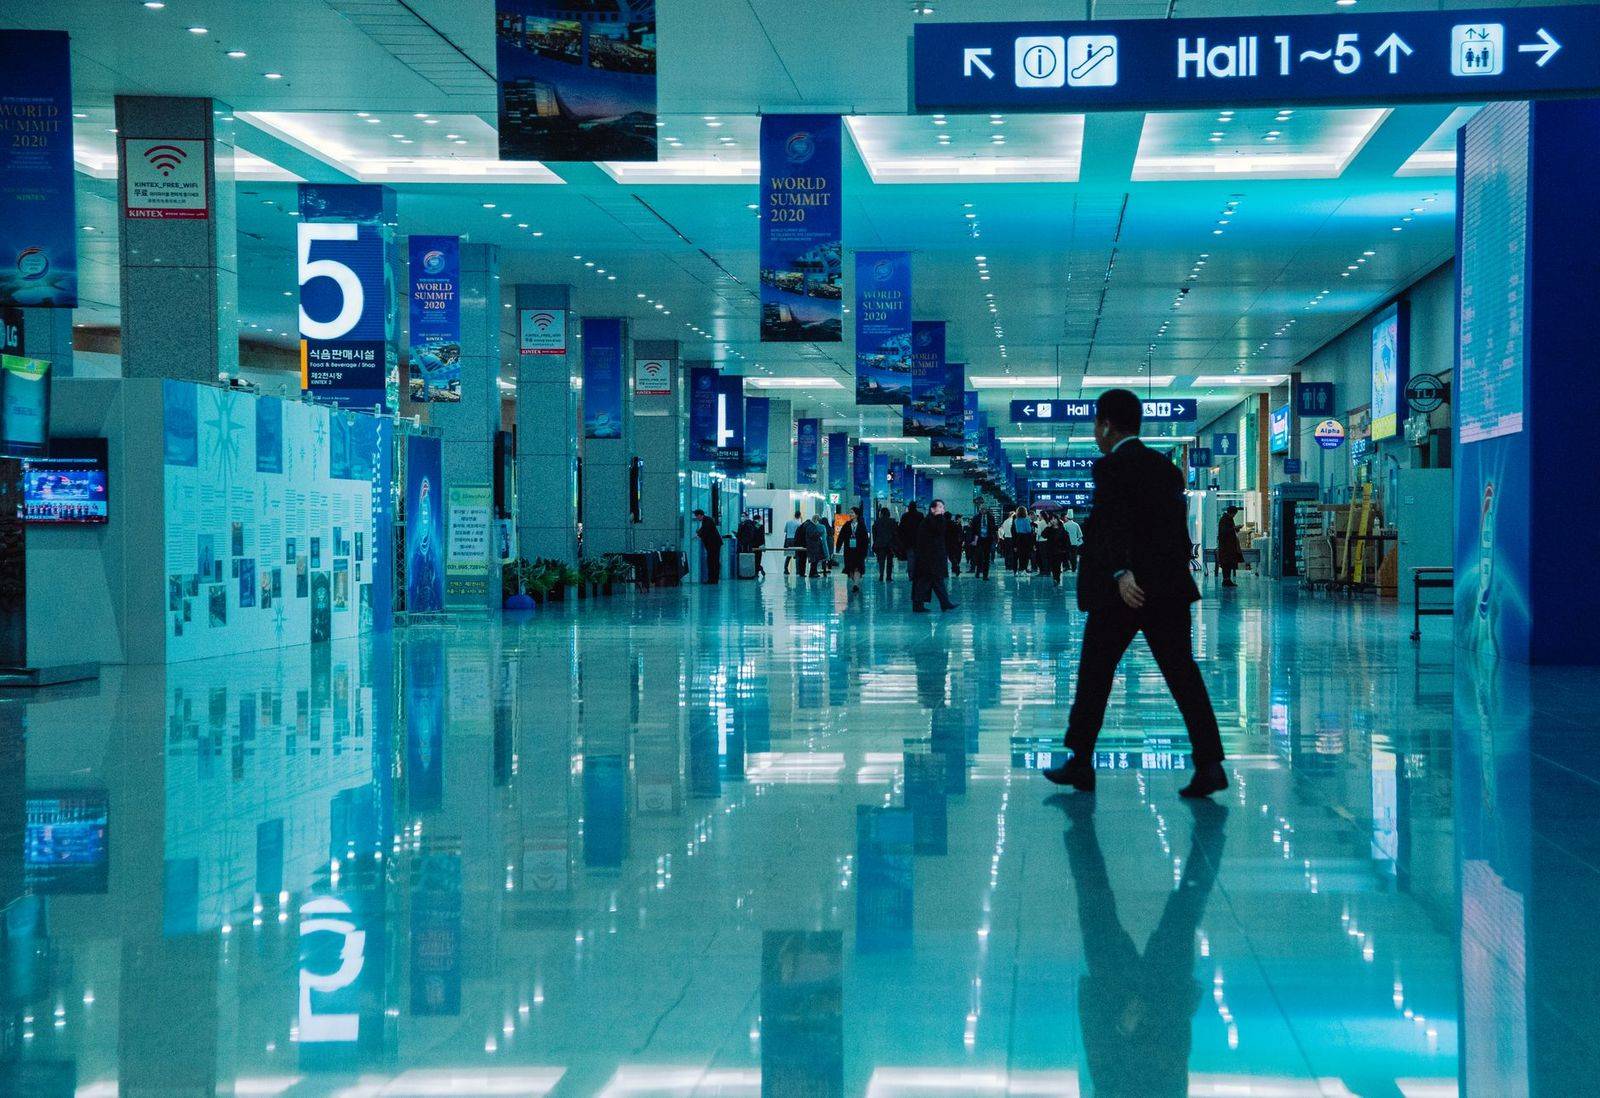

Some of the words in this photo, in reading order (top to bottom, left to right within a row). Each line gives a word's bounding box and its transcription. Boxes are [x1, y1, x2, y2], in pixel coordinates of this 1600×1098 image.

[1177, 36, 1257, 78] Hall
[1274, 33, 1361, 75] 1~5
[12, 135, 47, 147] 2020
[771, 177, 826, 190] WORLD
[770, 193, 831, 206] SUMMIT
[771, 209, 805, 222] 2020
[297, 222, 364, 340] 5
[416, 283, 452, 291] WORLD
[414, 292, 454, 300] SUMMIT
[863, 290, 902, 299] WORLD
[424, 301, 445, 309] 2020
[862, 301, 903, 310] SUMMIT
[863, 312, 887, 321] 2020
[6, 325, 18, 347] LG
[309, 349, 375, 360] 식음판매시설
[1067, 404, 1089, 416] Hall
